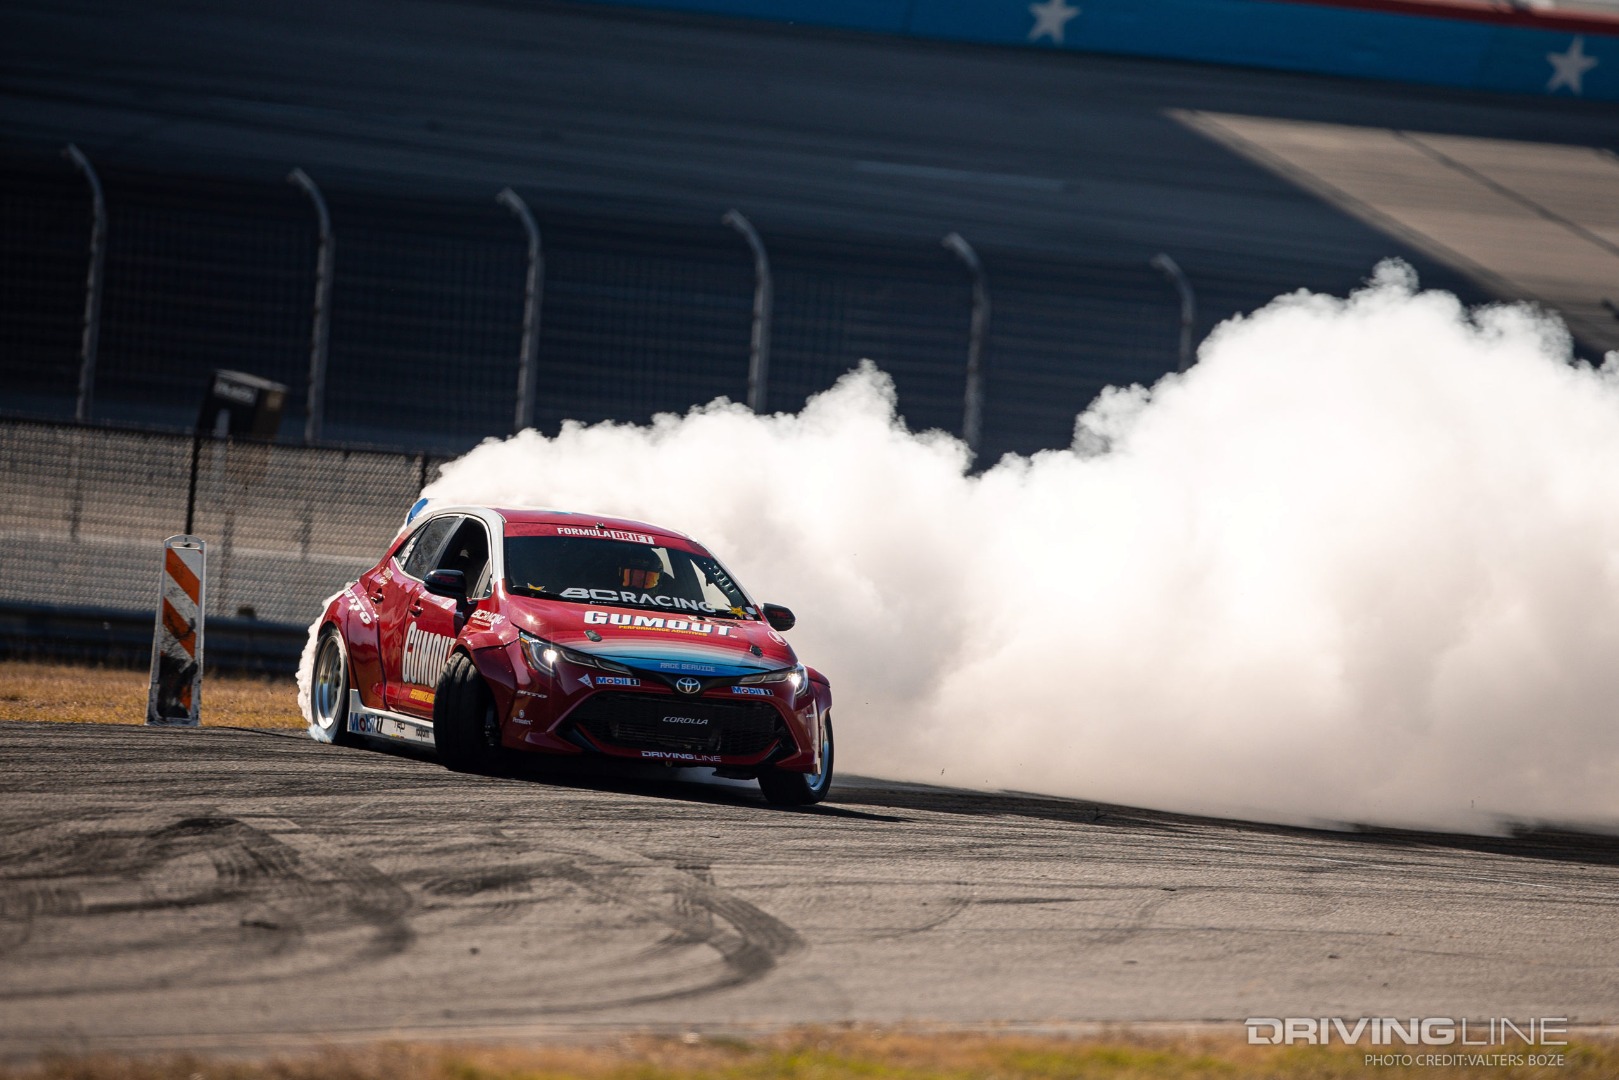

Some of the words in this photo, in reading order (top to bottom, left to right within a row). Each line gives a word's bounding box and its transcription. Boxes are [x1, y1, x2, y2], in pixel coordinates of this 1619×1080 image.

[584, 610, 733, 636] GUMOUT
[618, 625, 670, 633] PERFORMANCE
[402, 621, 458, 688] GUMOU
[660, 662, 680, 670] RACE
[681, 664, 716, 672] SERVICE
[596, 677, 628, 685] Mobil
[732, 686, 762, 694] Mobil
[662, 716, 709, 725] COROLLA
